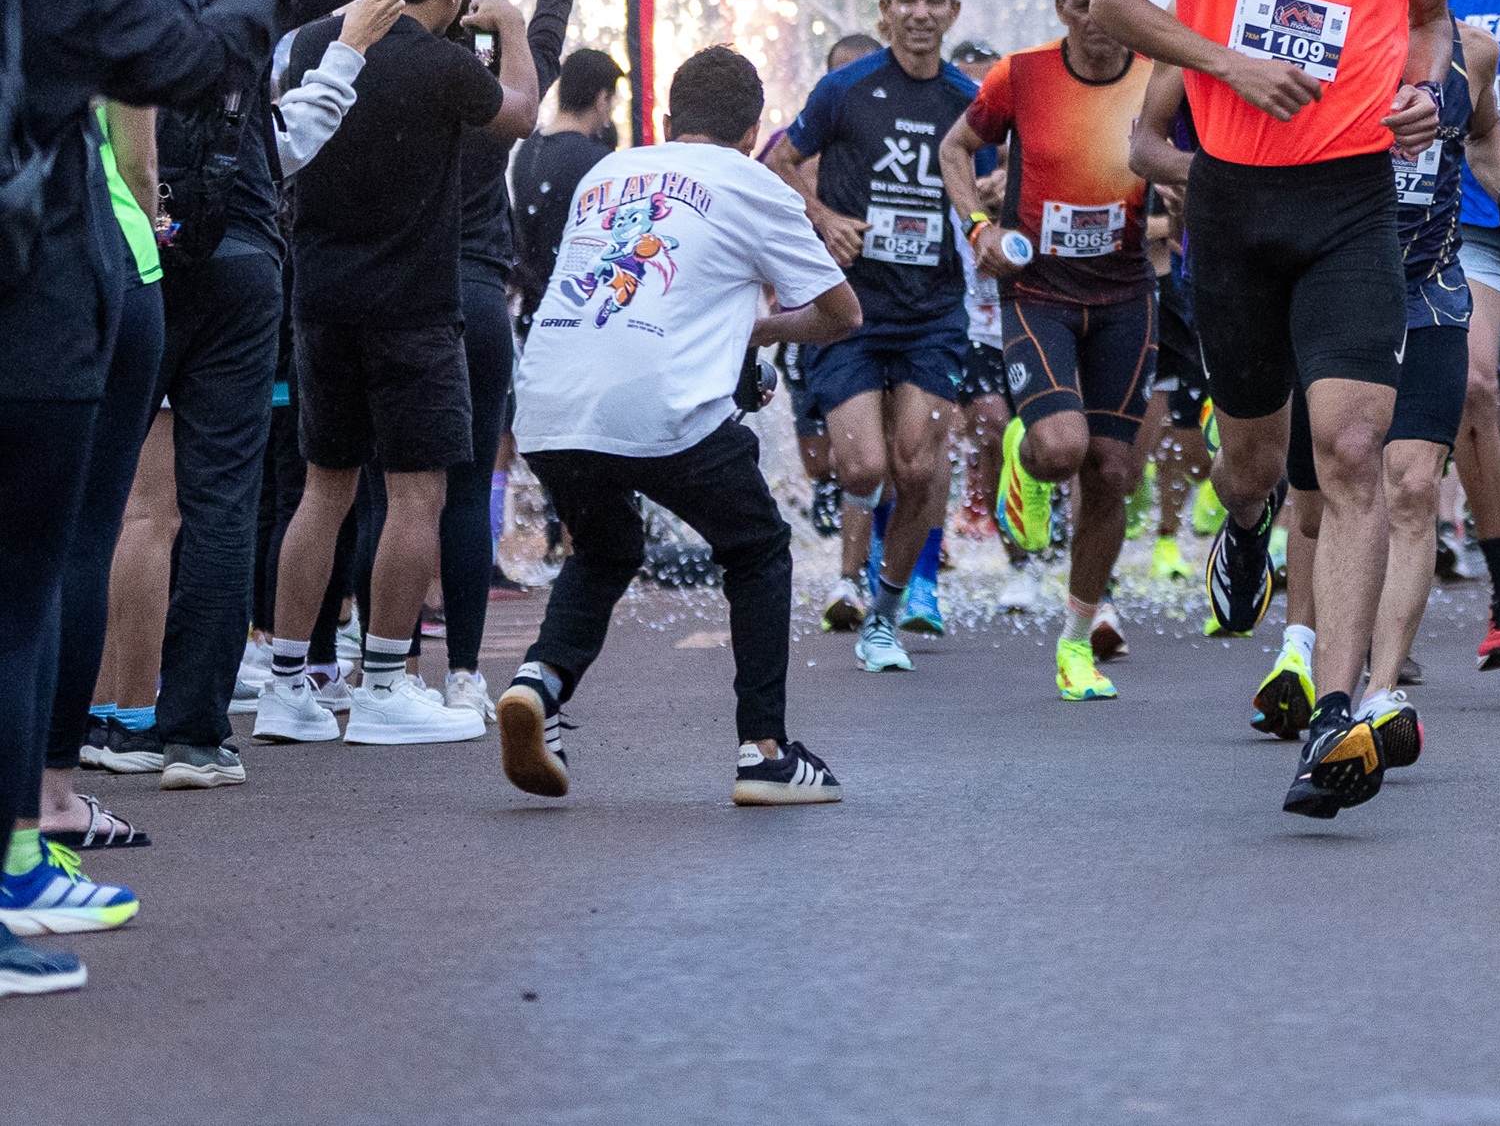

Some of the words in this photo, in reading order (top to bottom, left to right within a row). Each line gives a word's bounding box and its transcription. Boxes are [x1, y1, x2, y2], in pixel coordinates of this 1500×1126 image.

[1290, 22, 1321, 34] moderna
[1245, 31, 1259, 41] 7KM
[1260, 30, 1325, 62] 1109
[1325, 51, 1339, 60] 7KM
[895, 119, 936, 135] EQUIPE
[870, 180, 887, 191] EM
[576, 174, 658, 227] PLAY
[884, 237, 930, 255] 0547
[1064, 232, 1113, 248] 0965
[540, 319, 582, 327] GAME
